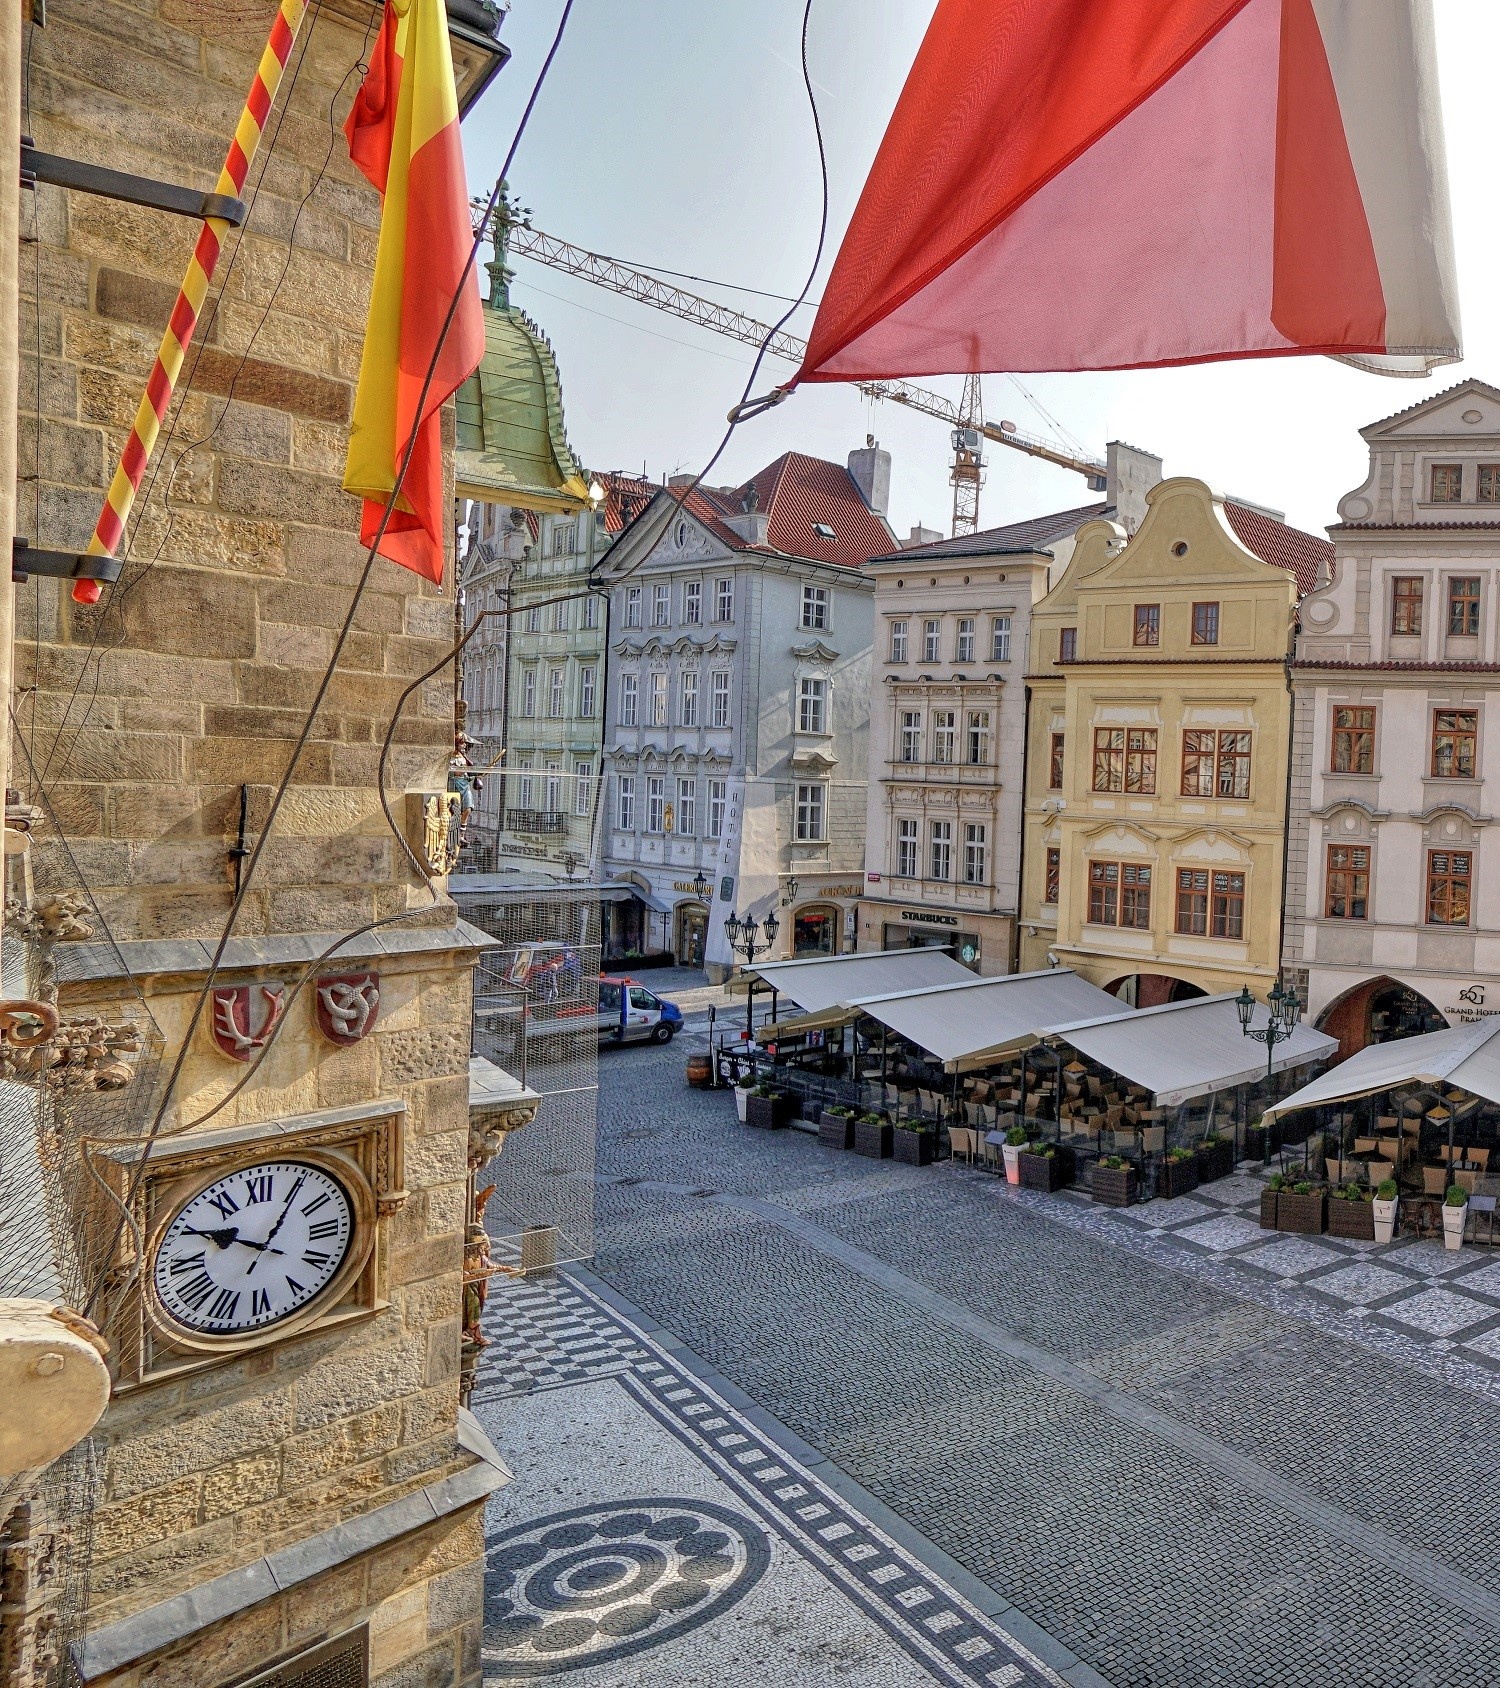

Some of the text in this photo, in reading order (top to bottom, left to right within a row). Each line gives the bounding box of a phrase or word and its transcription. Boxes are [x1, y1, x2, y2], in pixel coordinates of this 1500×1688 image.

[724, 793, 738, 863] HOTEL
[901, 911, 957, 926] STARBUCKS
[1444, 1006, 1474, 1015] GRAND
[1460, 1015, 1482, 1023] PRAH
[245, 1175, 274, 1207] XII
[207, 1190, 240, 1222] XI
[300, 1192, 331, 1217] II
[309, 1218, 339, 1241] III
[285, 1275, 305, 1297] V
[206, 1288, 241, 1320] VII
[252, 1287, 272, 1317] VI
